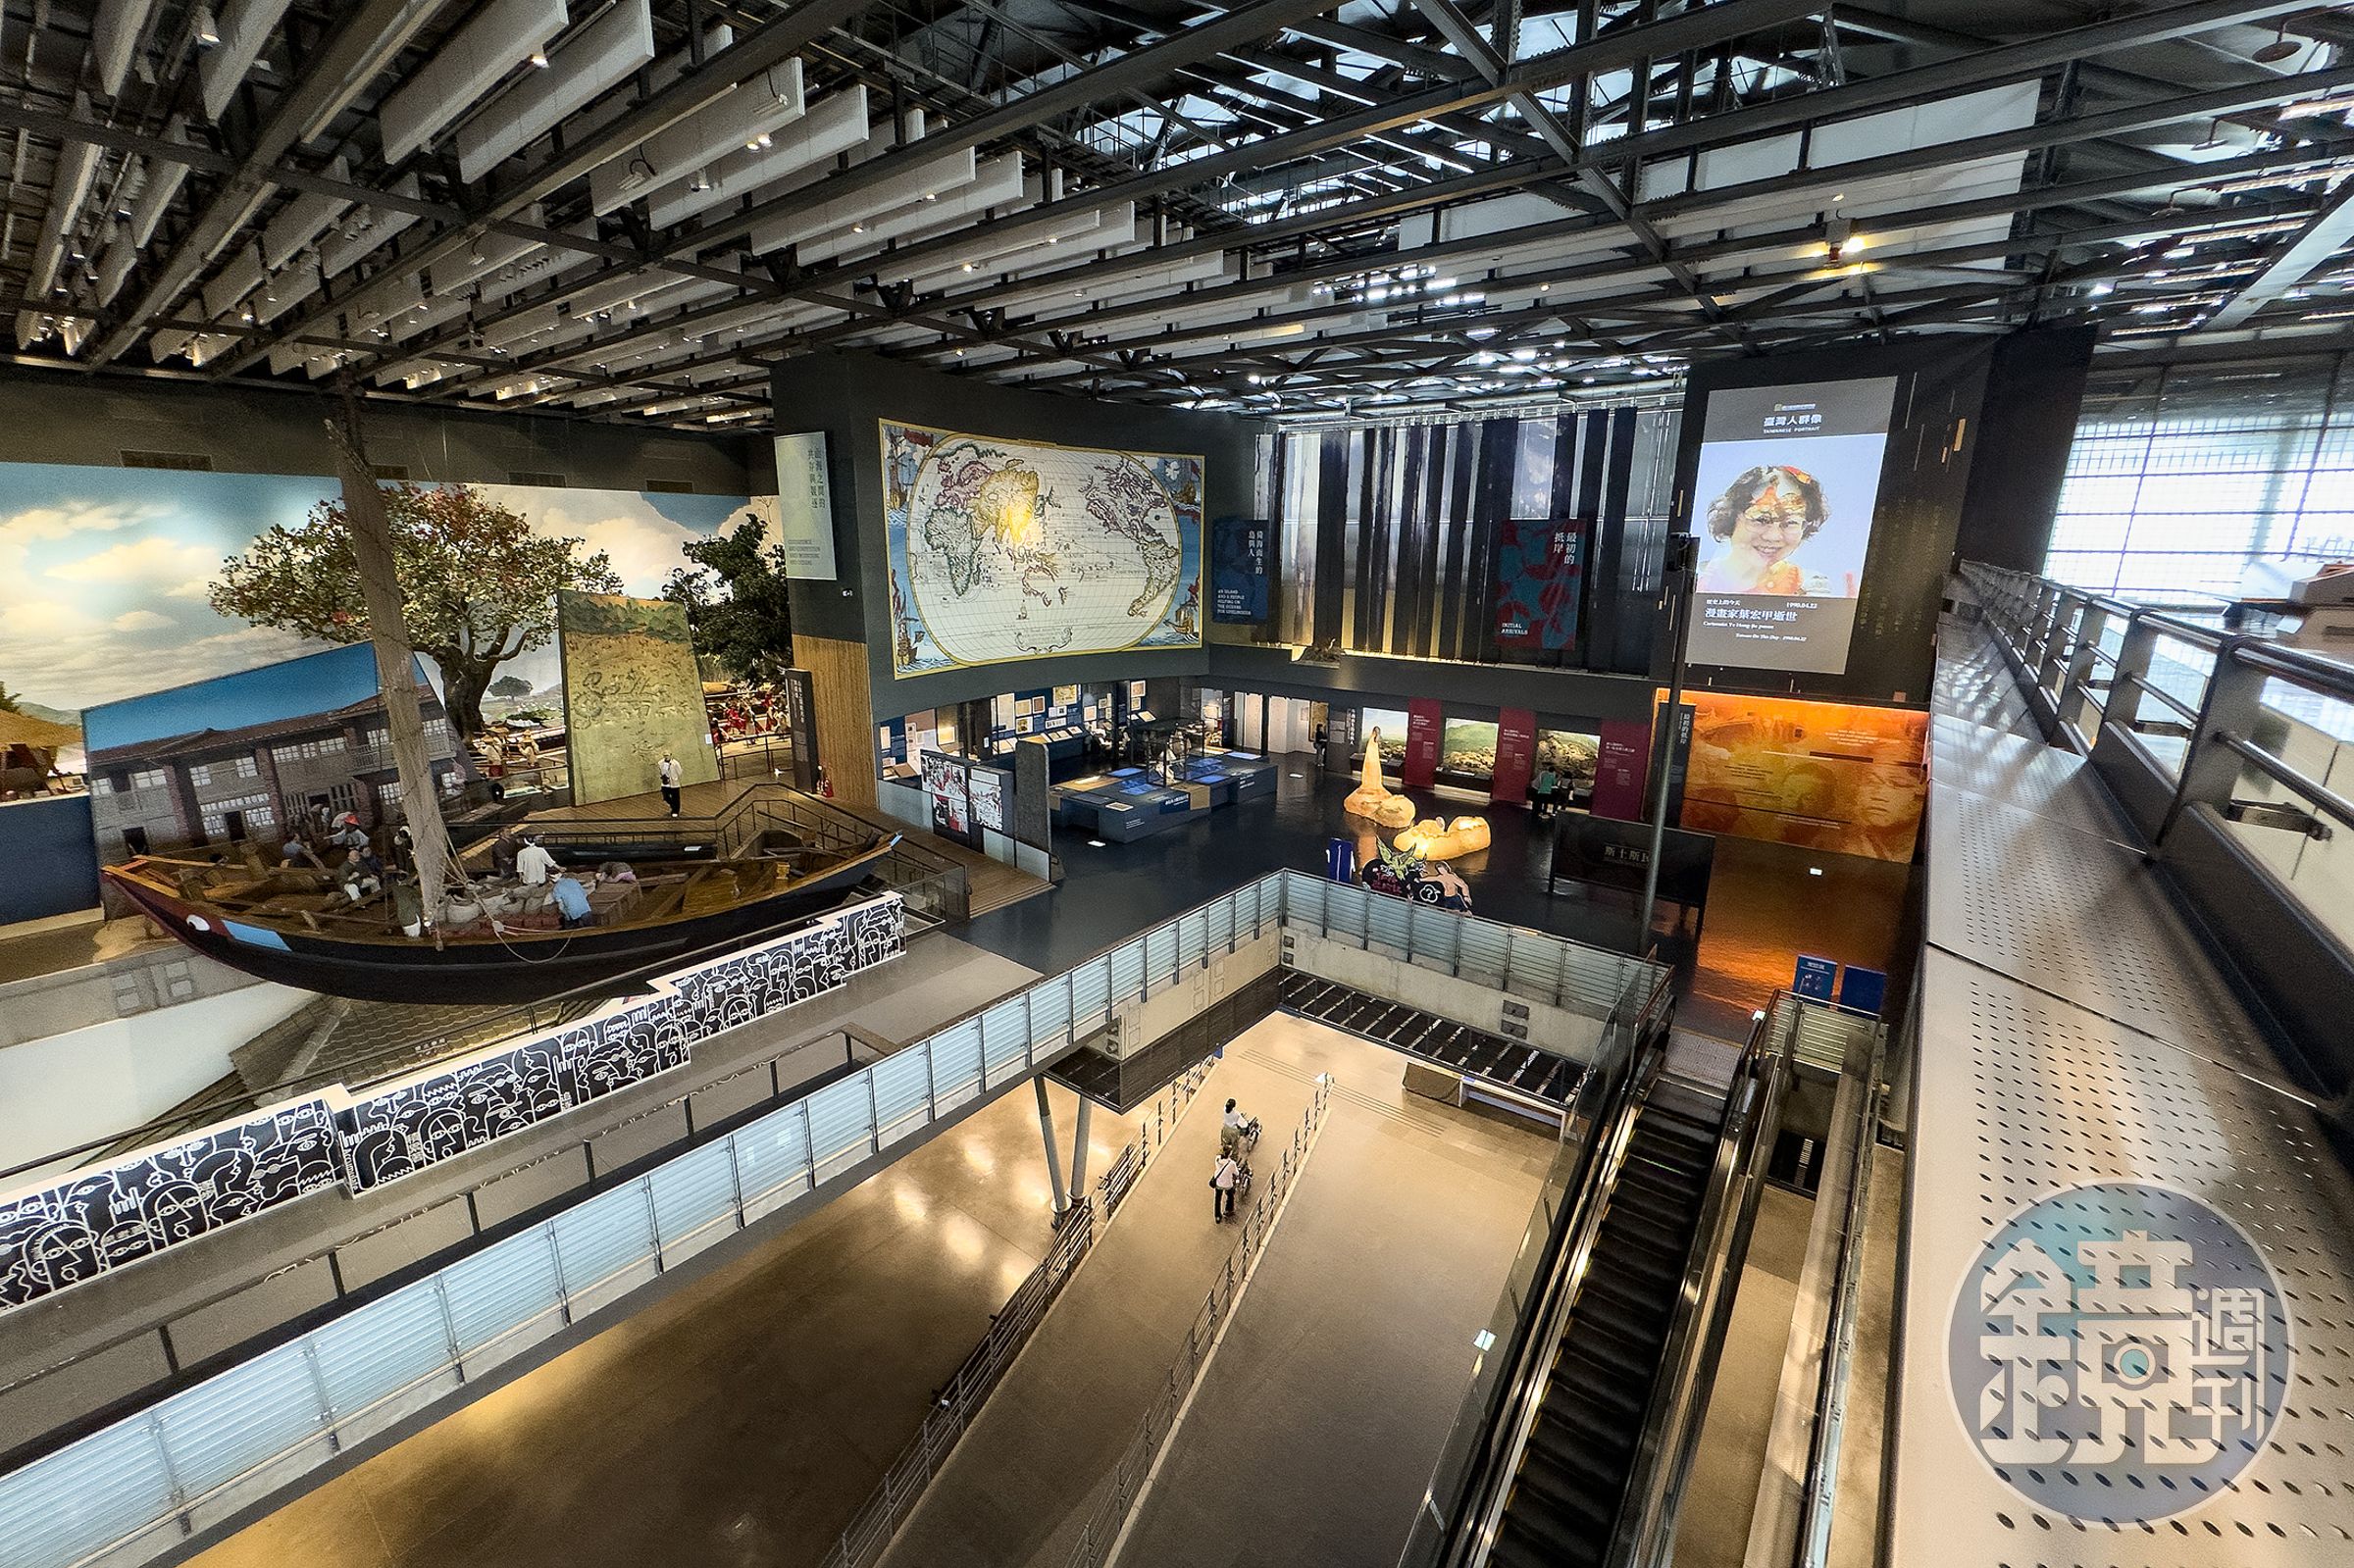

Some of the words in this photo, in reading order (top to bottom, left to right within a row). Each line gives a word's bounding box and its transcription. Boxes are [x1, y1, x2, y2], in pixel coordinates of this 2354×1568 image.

[1553, 531, 1564, 554] 抵岸
[1563, 531, 1577, 565] 最初的
[1705, 607, 1798, 622] 漫畫家葉宏甲逝世
